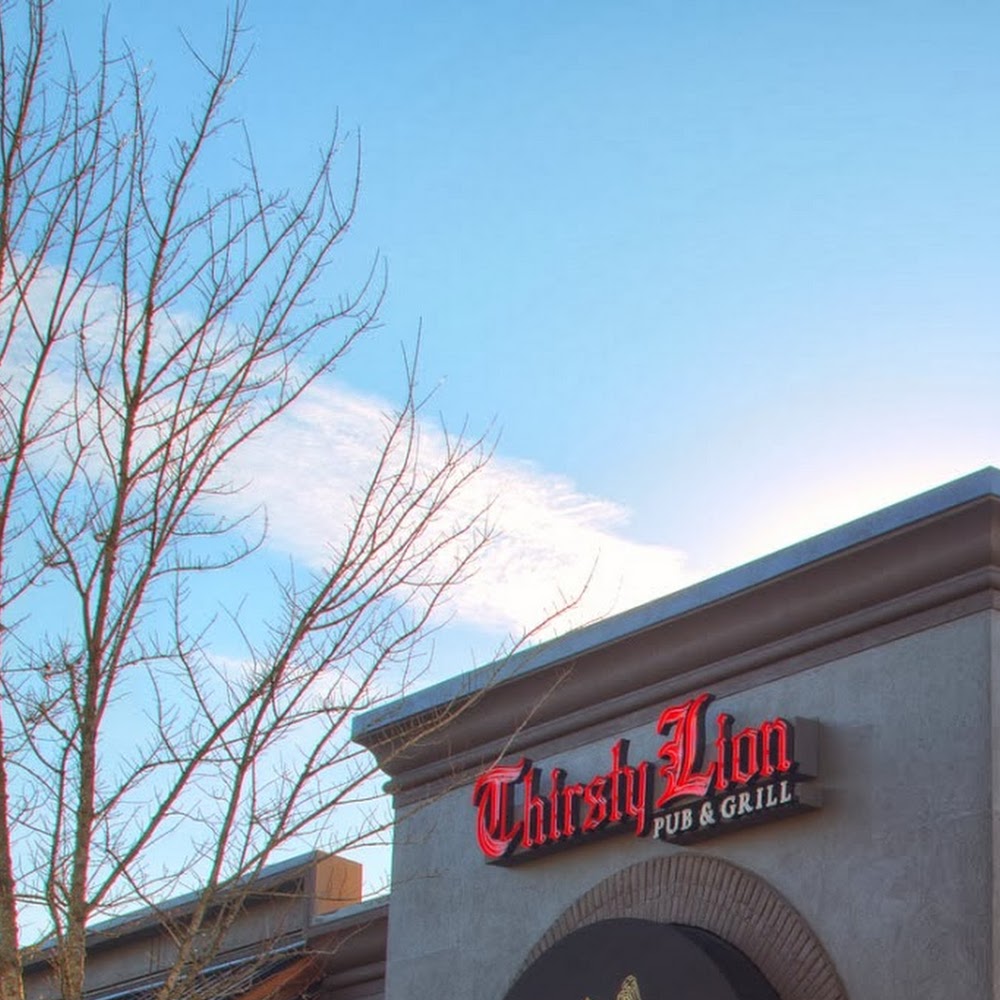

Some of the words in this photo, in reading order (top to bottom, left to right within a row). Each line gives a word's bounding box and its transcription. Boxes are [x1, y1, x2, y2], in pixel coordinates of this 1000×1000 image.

[473, 738, 649, 859] Thirsty
[656, 692, 793, 808] Lion
[653, 809, 693, 839] PUB
[700, 801, 715, 826] &
[721, 781, 791, 818] GRILL
